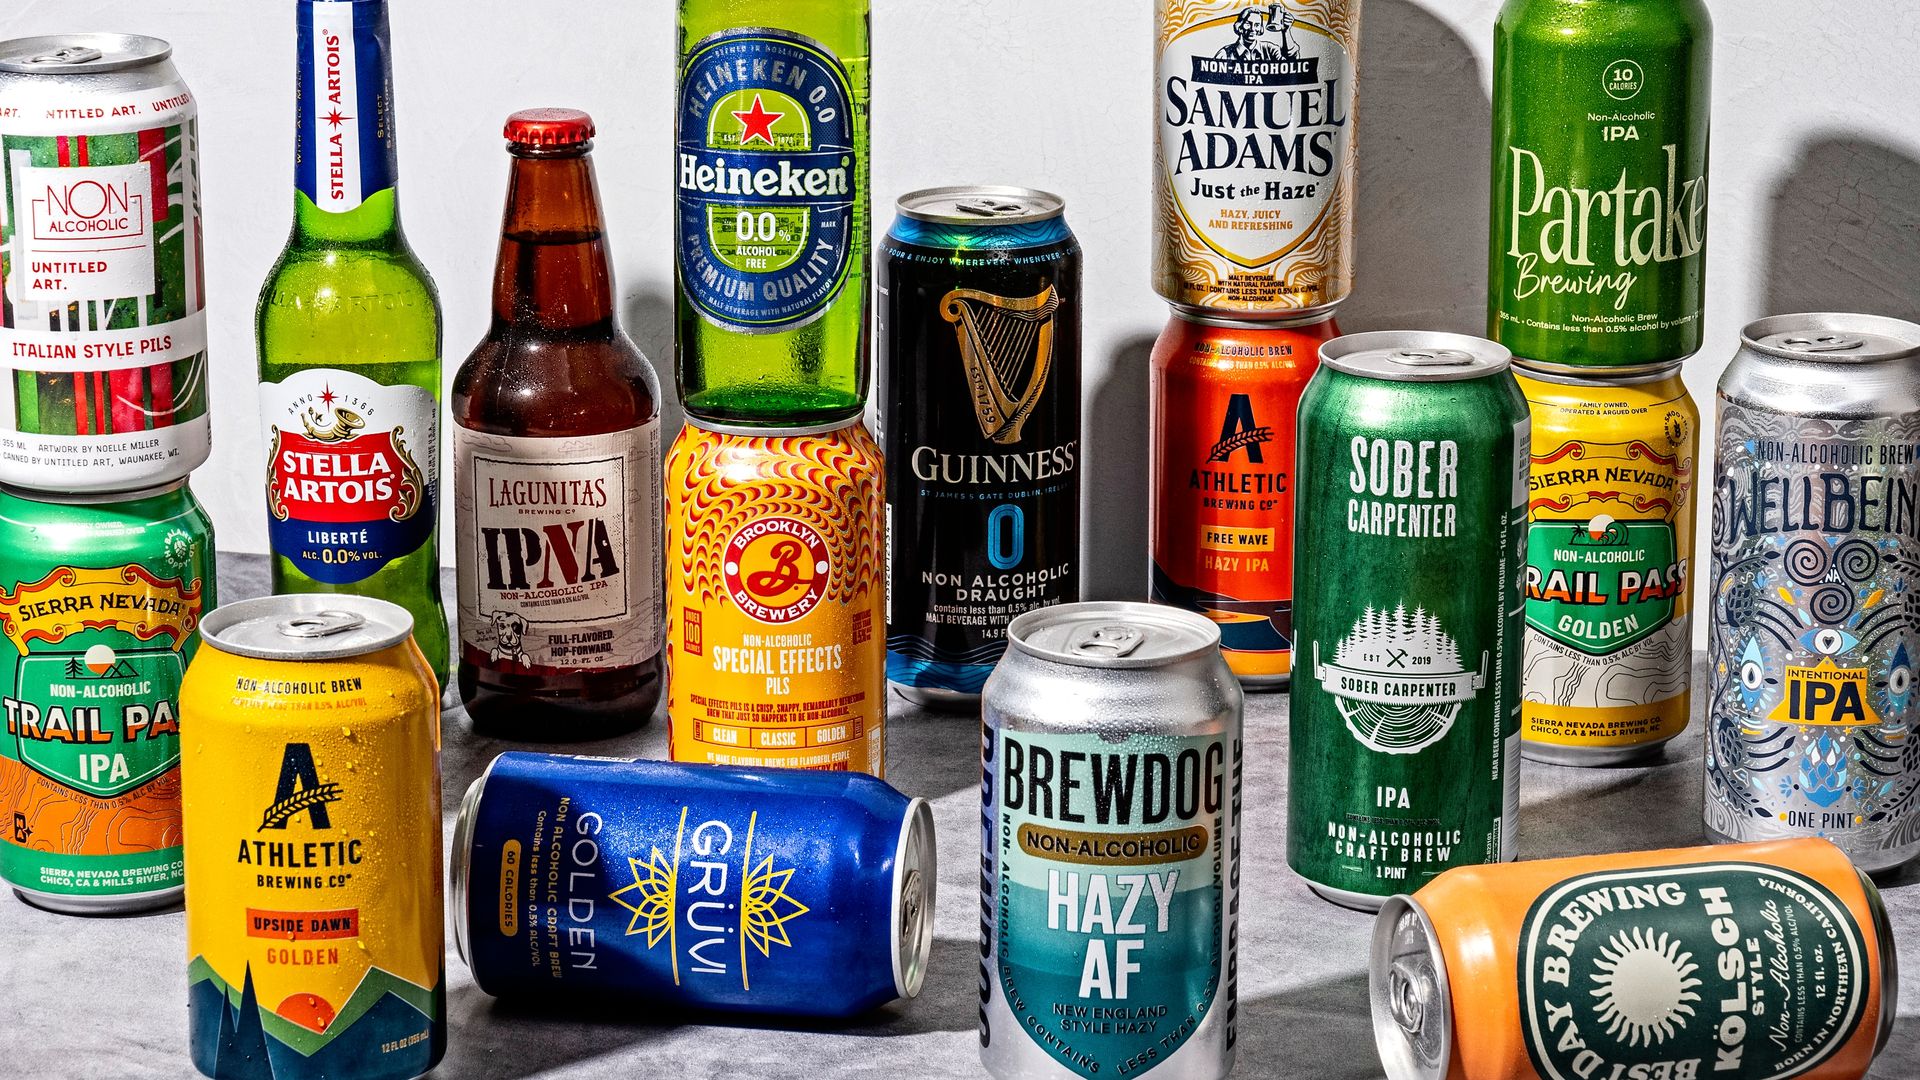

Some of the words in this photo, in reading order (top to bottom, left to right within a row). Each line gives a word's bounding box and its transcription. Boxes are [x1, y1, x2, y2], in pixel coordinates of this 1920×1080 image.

[326, 35, 341, 105] ARTOIS
[1200, 59, 1309, 74] NON-ALCOHOLIC
[1613, 69, 1633, 81] 10
[689, 59, 808, 118] HEINEKEN
[809, 85, 836, 123] 0.0
[1245, 75, 1263, 84] IPA
[1609, 82, 1637, 90] CALORIES
[1166, 76, 1346, 129] SAMUEL
[1587, 111, 1655, 122] Non-Alcoholic
[1603, 126, 1639, 141] IPA
[1175, 129, 1333, 177] ADAMS
[331, 133, 344, 200] STELLA
[680, 154, 849, 196] Heineken
[47, 181, 128, 218] NON
[1190, 177, 1235, 200] Just
[1240, 186, 1260, 197] the
[1264, 182, 1315, 200] Haze
[1252, 210, 1280, 219] JUICY
[1507, 143, 1707, 267] Partake
[49, 218, 128, 232] ALCOHOLIC
[1209, 220, 1229, 229] AND
[1232, 221, 1293, 230] REFRESHING
[736, 246, 776, 256] ALCOHOL
[32, 262, 107, 273] UNTITLED
[688, 234, 754, 301] PREMIUM
[763, 238, 833, 300] QUALITY
[746, 259, 766, 268] FREE
[33, 279, 67, 290] ART.
[1514, 252, 1637, 310] Brewing
[1526, 319, 1560, 331] Contains
[1563, 324, 1580, 332] less
[1583, 325, 1603, 333] than
[1606, 325, 1627, 333] 0.5%
[1629, 323, 1659, 332] alcohol
[1572, 314, 1635, 323] Non-Alcoholic
[1638, 312, 1658, 321] Brew
[13, 343, 76, 358] ITALIAN
[84, 342, 133, 358] STYLE
[141, 336, 172, 354] PILS
[288, 394, 313, 414] ANNO
[345, 395, 375, 416] 1366
[39, 443, 78, 453] ARTWORK
[82, 445, 92, 453] BY
[96, 444, 126, 452] NOELLE
[130, 439, 159, 450] MILLER
[1758, 440, 1872, 465] NON-ALCOHOLIC
[1880, 445, 1914, 464] BREW
[283, 451, 391, 476] STELLA
[911, 442, 1075, 484] GUINNESS
[1350, 436, 1458, 498] SOBER
[284, 477, 393, 503] ARTOIS
[1189, 469, 1287, 493] ATHLETIC
[1530, 469, 1600, 490] SIERRA
[1605, 466, 1673, 491] NEVADA
[489, 478, 607, 508] LAGUNITAS
[1204, 498, 1255, 510] BREWING
[1348, 499, 1456, 537] CARPENTER
[1729, 471, 1920, 544] WELLBEIN
[308, 528, 368, 544] LIBERTÉ
[734, 521, 819, 550] BROOKLYN
[988, 503, 1024, 569] 0
[1207, 532, 1233, 544] FREE
[1238, 535, 1268, 545] WAVE
[302, 550, 320, 559] ALC.
[322, 549, 360, 563] 0.0%
[481, 518, 619, 590] IPNA
[1205, 556, 1239, 571] HAZY
[1246, 558, 1269, 571] IPA
[1554, 549, 1645, 563] NON-ALCOHOLIC
[922, 571, 961, 587] NON
[972, 563, 1069, 587] ALCOHOLIC
[1526, 565, 1608, 604] RAIL
[1618, 558, 1686, 604] PASS
[500, 585, 583, 600] NON-ALCOHOLIC
[590, 580, 608, 590] IPA
[957, 584, 1046, 601] DRAUGHT
[19, 594, 94, 622] SIERRA
[100, 592, 180, 616] NEVADA
[734, 589, 818, 620] BREWERY
[549, 630, 614, 644] FULL-FLAVORED.
[1558, 613, 1638, 640] GOLDEN
[551, 642, 613, 657] HOP-FORWARD.
[743, 634, 812, 647] NON-ALCOHOLIC
[1533, 633, 1564, 653] CONTAINS
[1564, 650, 1581, 661] LESS
[1583, 656, 1600, 666] THAN
[713, 646, 774, 674] SPECIAL
[780, 644, 842, 674] EFFECTS
[1363, 654, 1380, 663] EST
[1412, 656, 1431, 665] 2019
[236, 678, 326, 694] NON-ALCOHOLIC
[331, 677, 362, 693] BREW
[766, 677, 790, 695] PILS
[1788, 669, 1865, 680] INTENTIONAL
[50, 681, 151, 697] NON-ALCOHOLIC
[1340, 677, 1378, 695] SOBER
[1384, 682, 1456, 697] CARPENTER
[1789, 680, 1865, 721] IPA
[3, 698, 113, 743] TRAIL
[124, 700, 180, 742] PA
[713, 728, 737, 744] CLEAN
[761, 731, 796, 746] CLASSIC
[817, 726, 846, 743] GOLDEN
[79, 754, 130, 783] IPA
[1004, 736, 1224, 825] BREWDOG
[1377, 786, 1410, 809] IPA
[557, 797, 570, 822] NON
[1788, 811, 1815, 827] ONE
[1822, 813, 1853, 828] PINT
[1027, 831, 1200, 857] NON-ALCOHOLIC
[1328, 822, 1461, 846] NON-ALCOHOLIC
[238, 839, 362, 868] ATHLETIC
[507, 851, 515, 865] 60
[1335, 840, 1389, 861] CRAFT
[1401, 847, 1450, 862] BREW
[548, 826, 564, 903] ALCOHOLIC
[1376, 867, 1381, 878] 1
[1385, 867, 1406, 879] PINT
[257, 876, 322, 888] BREWING
[568, 812, 603, 969] GOLDEN
[505, 868, 514, 927] CALORIES
[1048, 869, 1180, 934] HAZY
[1758, 877, 1837, 939] CALIFORNIA
[254, 917, 303, 932] UPSIDE
[311, 917, 350, 932] DAWN
[547, 908, 558, 947] CRAFT
[1543, 882, 1686, 988] BREWING
[267, 948, 338, 965] GOLDEN
[550, 950, 562, 978] BREW
[1815, 944, 1823, 962] oz.
[1079, 939, 1145, 999] AF
[1699, 887, 1747, 1071] KÖLSCH
[1746, 938, 1764, 1016] STYLE
[1760, 900, 1791, 1051] Non-Alcoholic
[1815, 967, 1825, 980] fl.
[1816, 984, 1826, 998] 12
[1826, 943, 1848, 1027] NORTHERN
[1053, 1003, 1089, 1018] NEW
[1093, 1004, 1167, 1018] ENGLAND
[1060, 1020, 1110, 1033] STYLE
[1115, 1021, 1157, 1034] HAZY
[1814, 1028, 1829, 1043] IN
[1544, 1000, 1604, 1080] DAY
[1775, 1044, 1813, 1071] BORN
